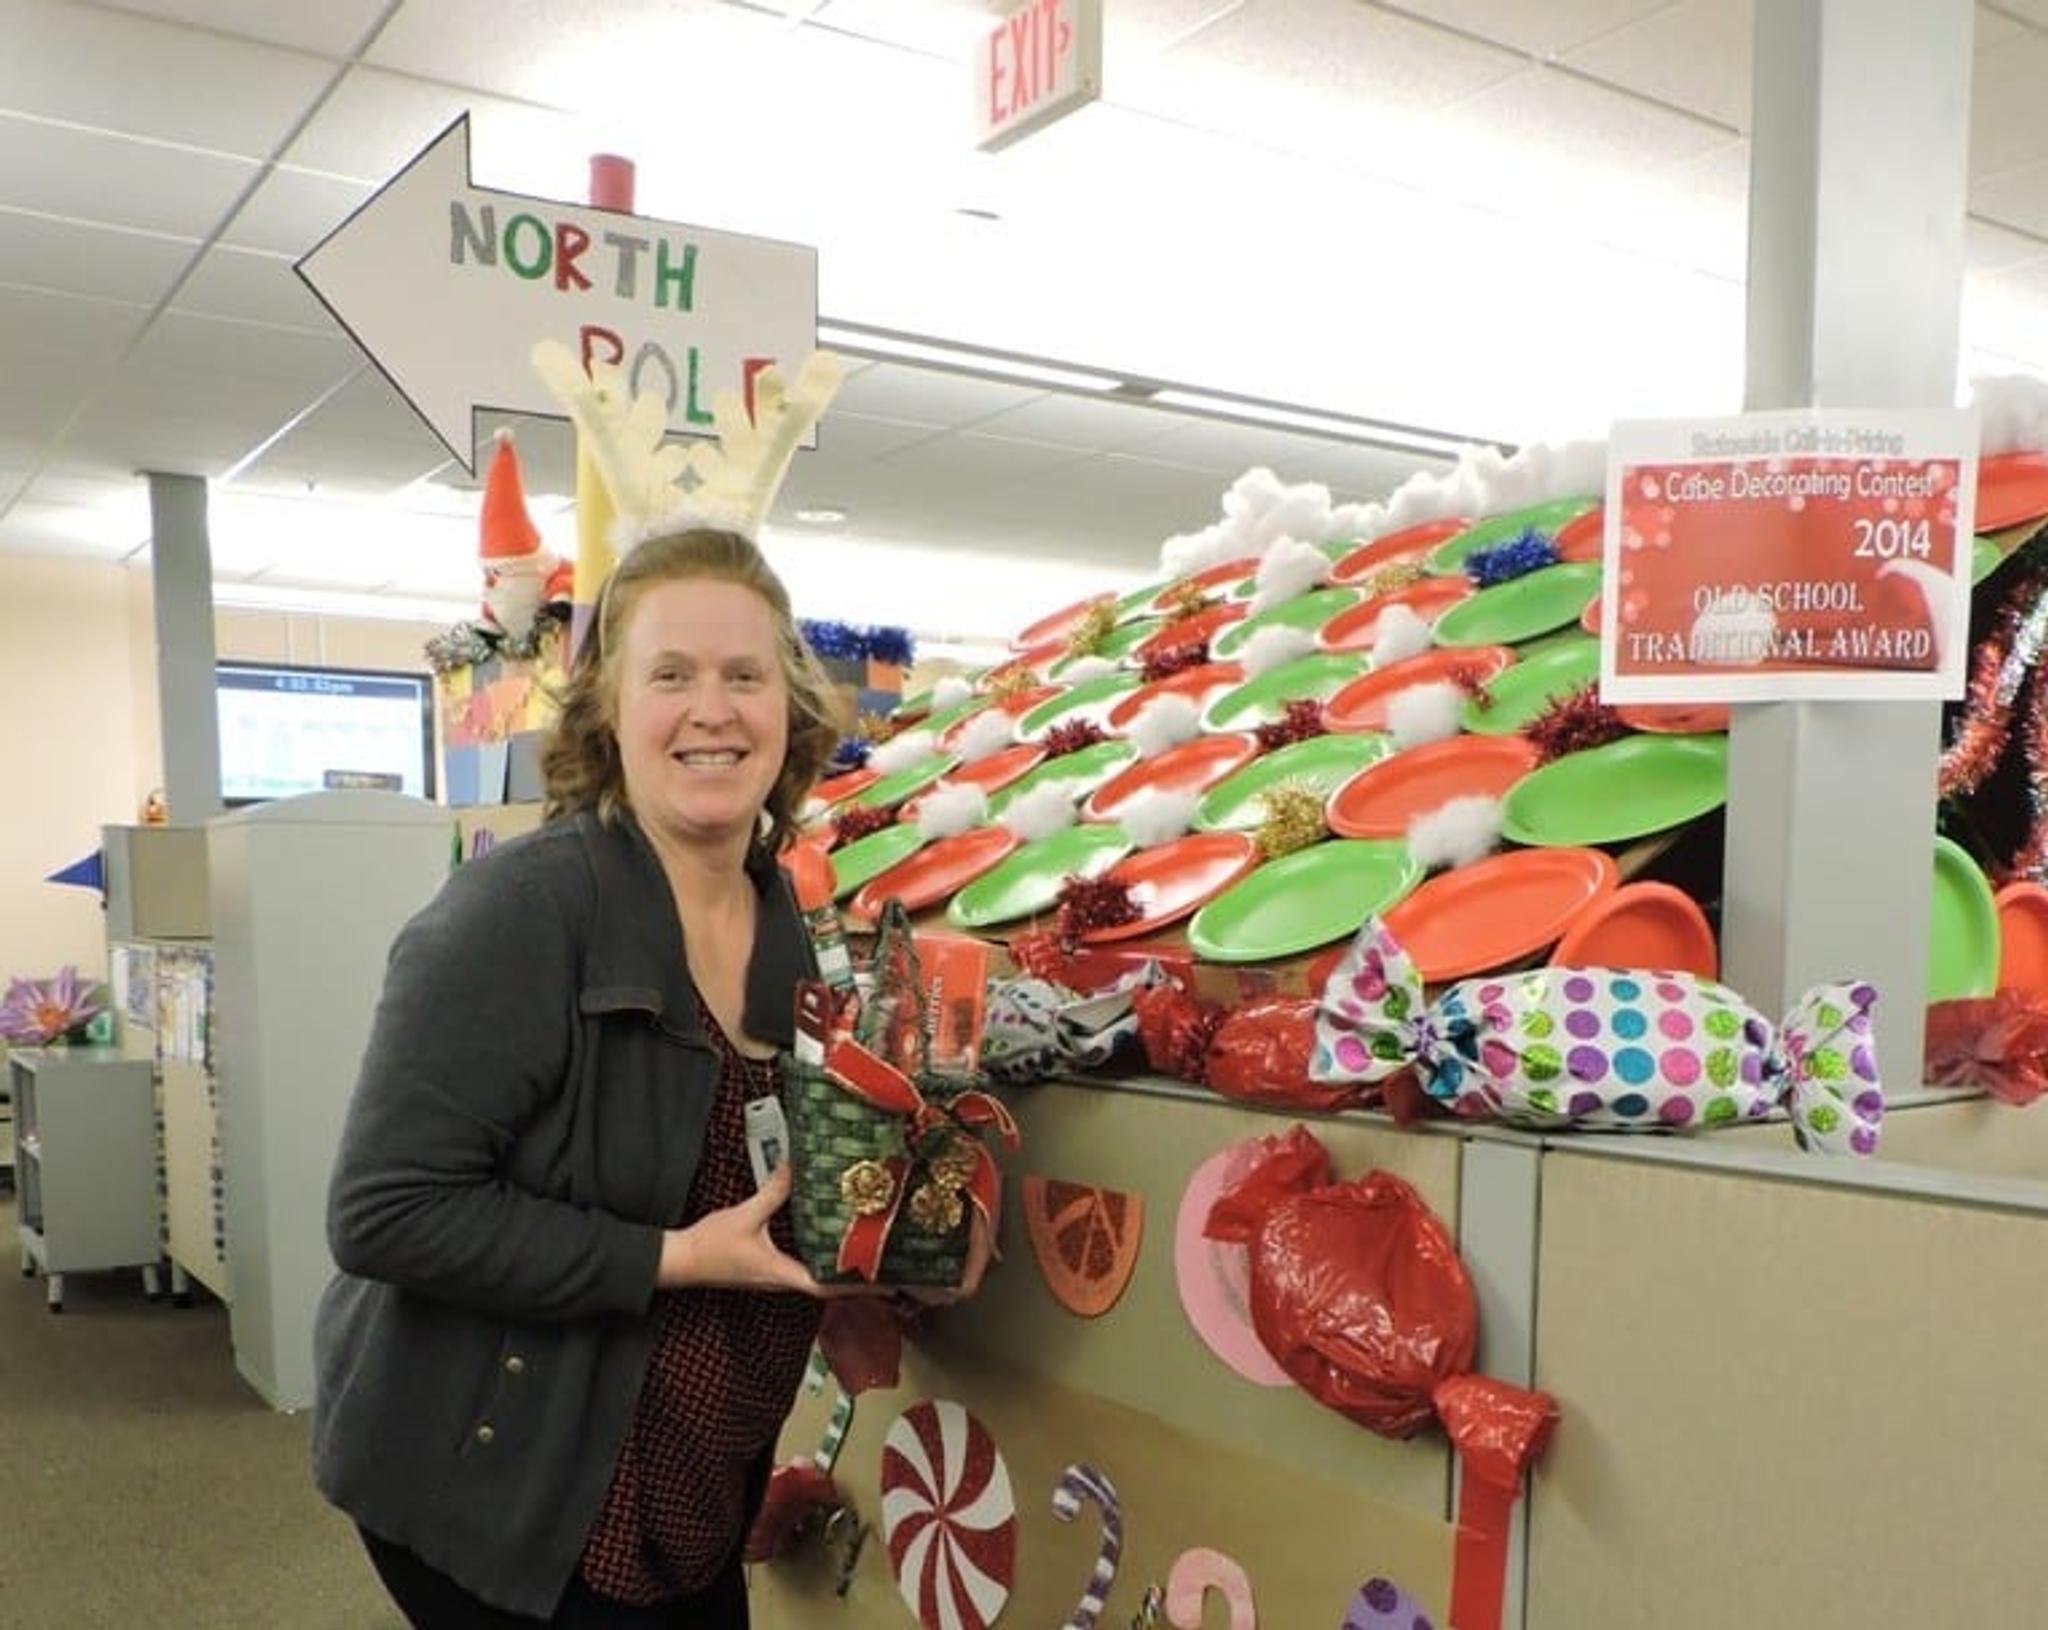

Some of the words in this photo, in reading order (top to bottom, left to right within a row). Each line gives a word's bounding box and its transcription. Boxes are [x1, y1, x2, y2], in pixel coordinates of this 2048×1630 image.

[990, 0, 1058, 125] EXIT
[449, 201, 698, 312] NORTH
[1665, 471, 1723, 501] Cube
[1729, 468, 1850, 500] Decorating
[1856, 465, 1934, 497] Contest
[1853, 518, 1932, 558] 2014
[1693, 582, 1750, 614] OLD
[1756, 580, 1865, 613] SCHOOL
[1628, 627, 1822, 662] TRADITIONAL
[1828, 624, 1931, 659] AWARD
